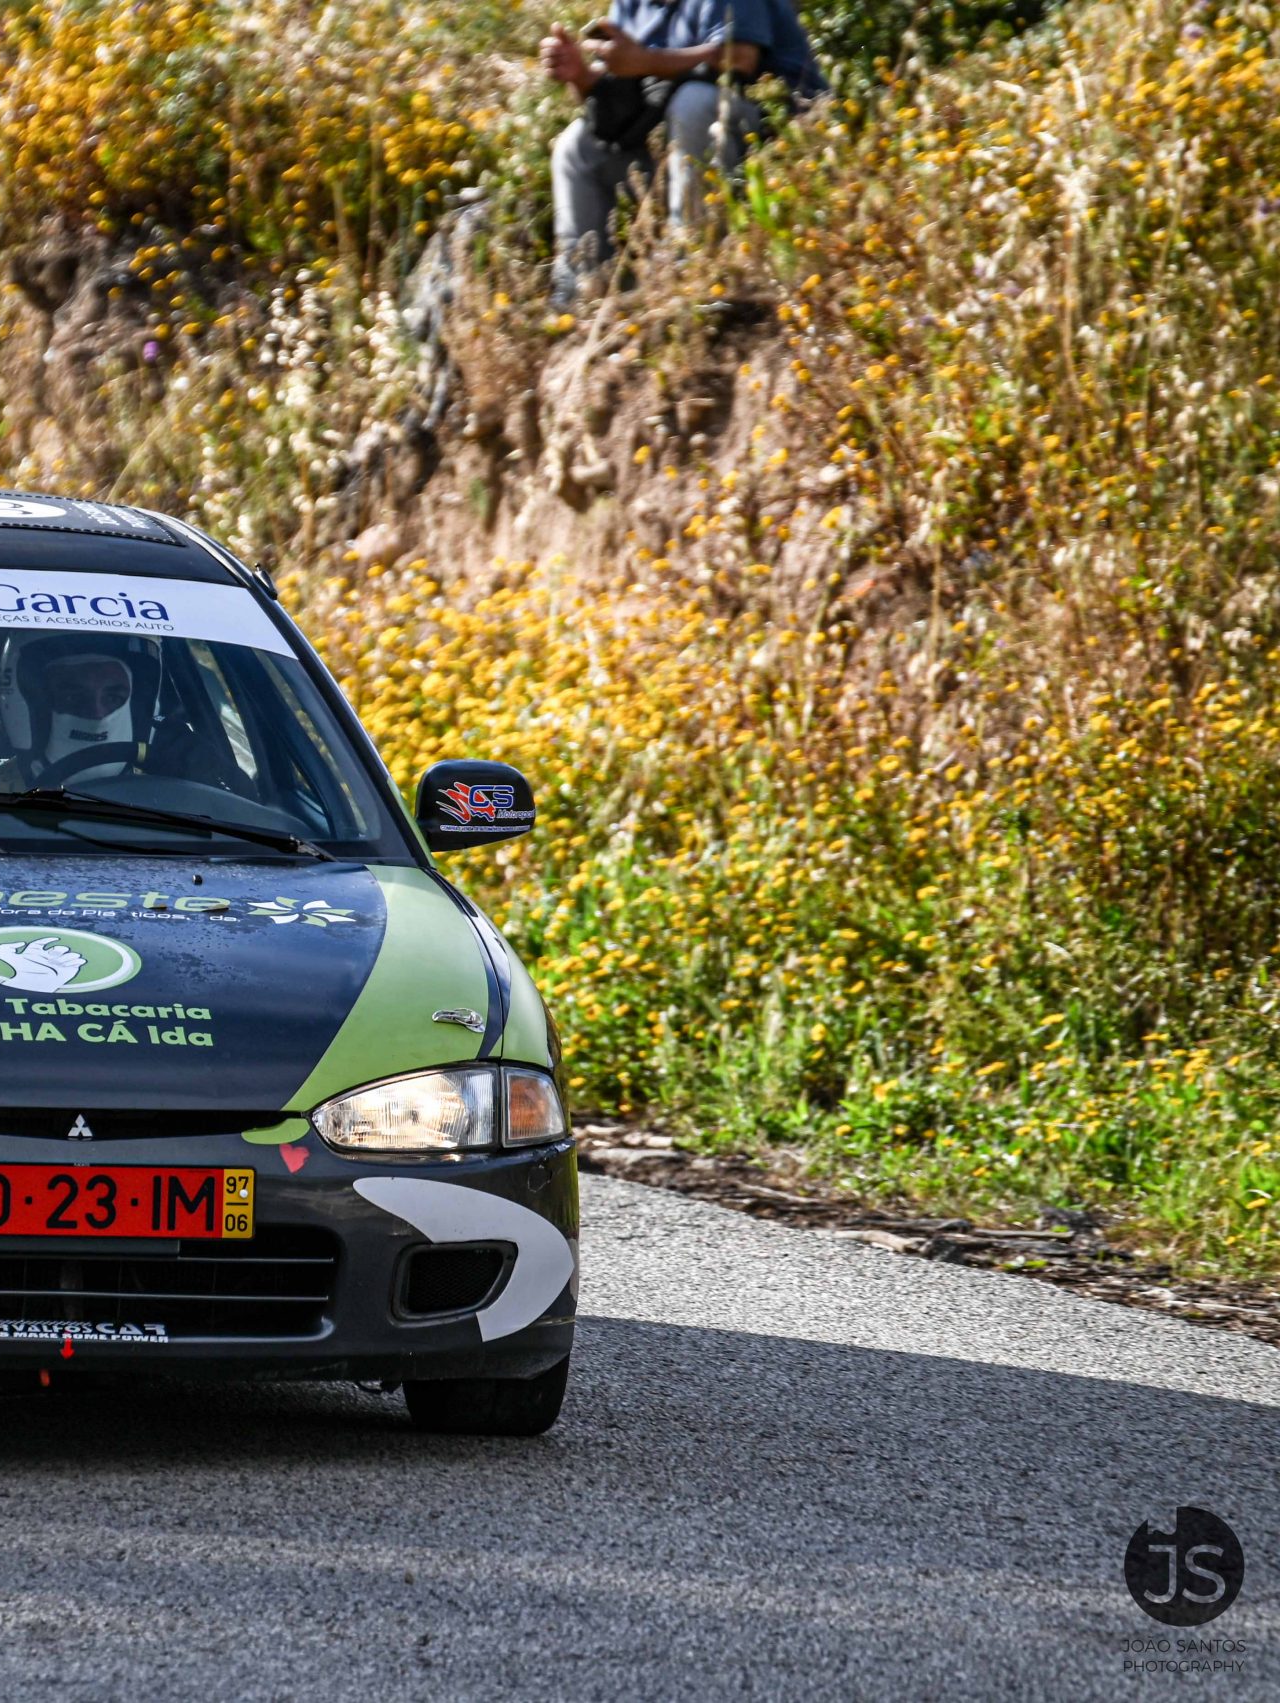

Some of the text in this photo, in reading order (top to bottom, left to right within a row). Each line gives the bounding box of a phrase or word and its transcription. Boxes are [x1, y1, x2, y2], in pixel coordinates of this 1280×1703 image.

[46, 616, 131, 628] ACESSÓRIOS
[134, 622, 174, 631] AUTO
[48, 908, 75, 916] de
[5, 998, 212, 1020] Tabacaria
[77, 1020, 139, 1044] CÁ
[226, 1176, 250, 1195] 97
[224, 1214, 249, 1233] 06
[111, 1334, 169, 1343] POWER
